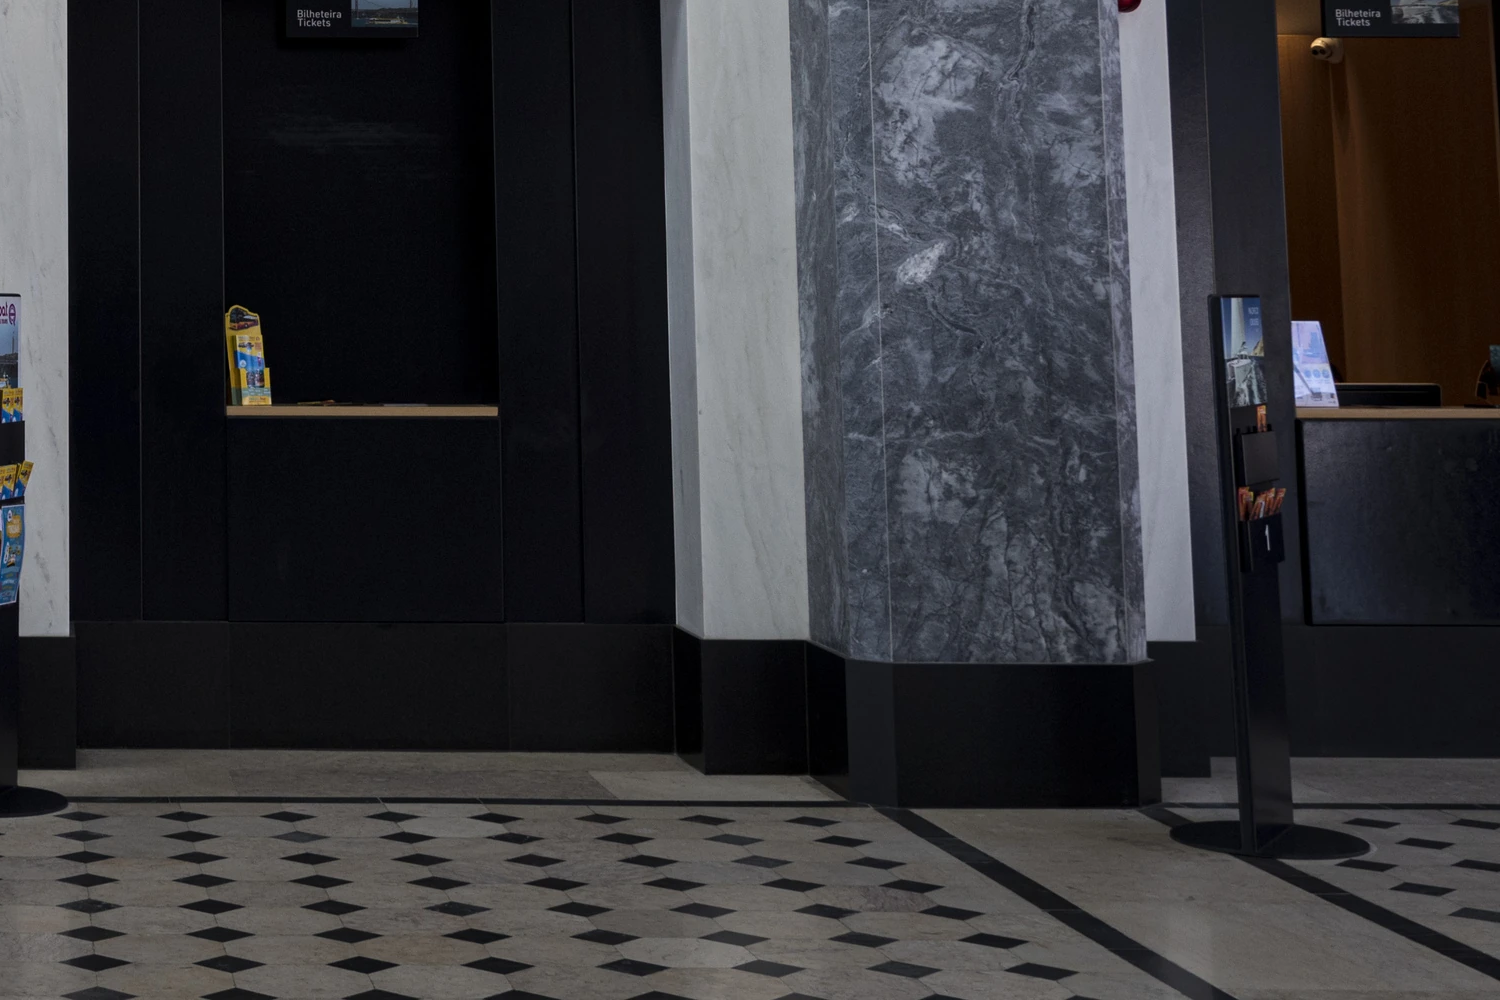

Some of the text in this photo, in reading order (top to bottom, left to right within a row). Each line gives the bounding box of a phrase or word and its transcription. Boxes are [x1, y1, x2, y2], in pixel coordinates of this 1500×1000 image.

[297, 10, 342, 18] Bilheteira
[1335, 9, 1381, 18] Bilheteira
[298, 19, 331, 27] Tickets
[1336, 18, 1371, 26] Tickets
